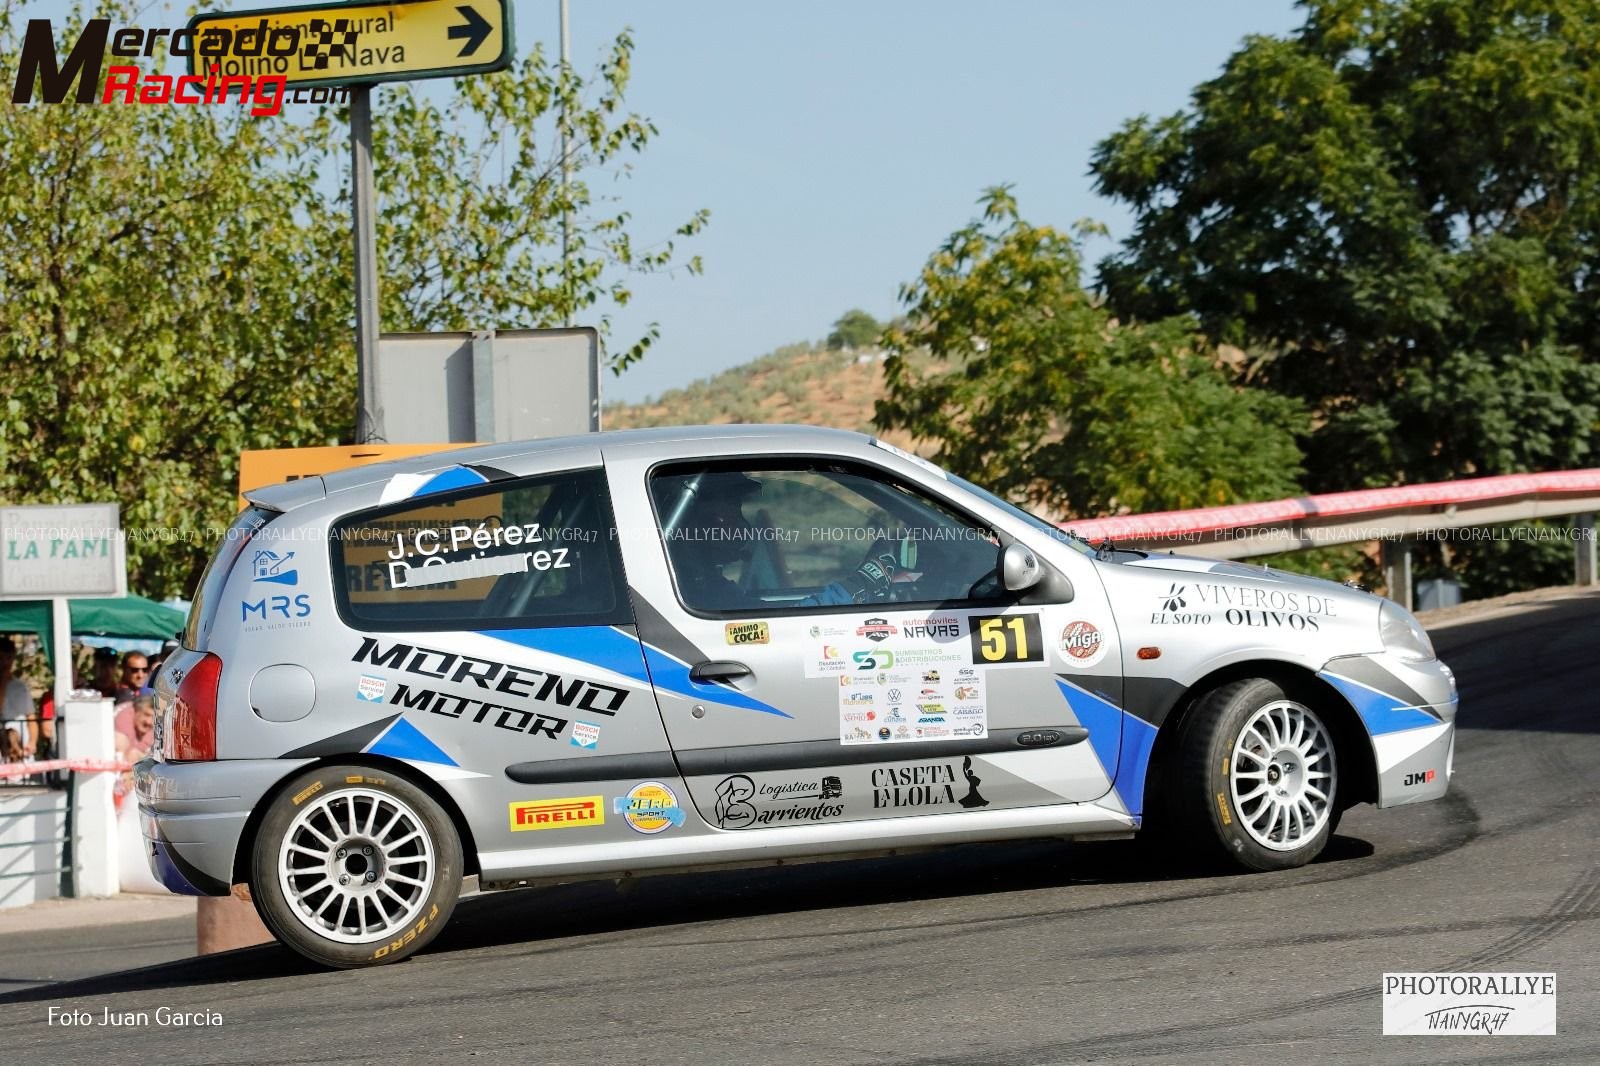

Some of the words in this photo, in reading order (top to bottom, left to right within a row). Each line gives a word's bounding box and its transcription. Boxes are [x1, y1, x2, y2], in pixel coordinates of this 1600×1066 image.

[343, 11, 395, 35] ural
[203, 53, 289, 80] Molino
[340, 43, 405, 68] Nava
[387, 522, 543, 560] J.C.Pérez
[241, 594, 312, 622] MRS
[1194, 583, 1299, 612] VIVEROS
[1307, 595, 1337, 617] DE
[1150, 612, 1168, 625] EL
[1173, 613, 1212, 625] SOTO
[1225, 608, 1319, 633] OLIVOS
[904, 624, 960, 638] NAVAS
[980, 617, 1028, 662] 51
[351, 636, 630, 717] MORENO
[361, 678, 385, 687] BOSCH
[389, 683, 568, 741] MOTOR
[575, 723, 599, 734] BOSCH
[871, 764, 956, 787] CASETA
[1404, 770, 1435, 787] JMP
[893, 785, 955, 808] LOLA
[516, 801, 596, 825] PIRELLI
